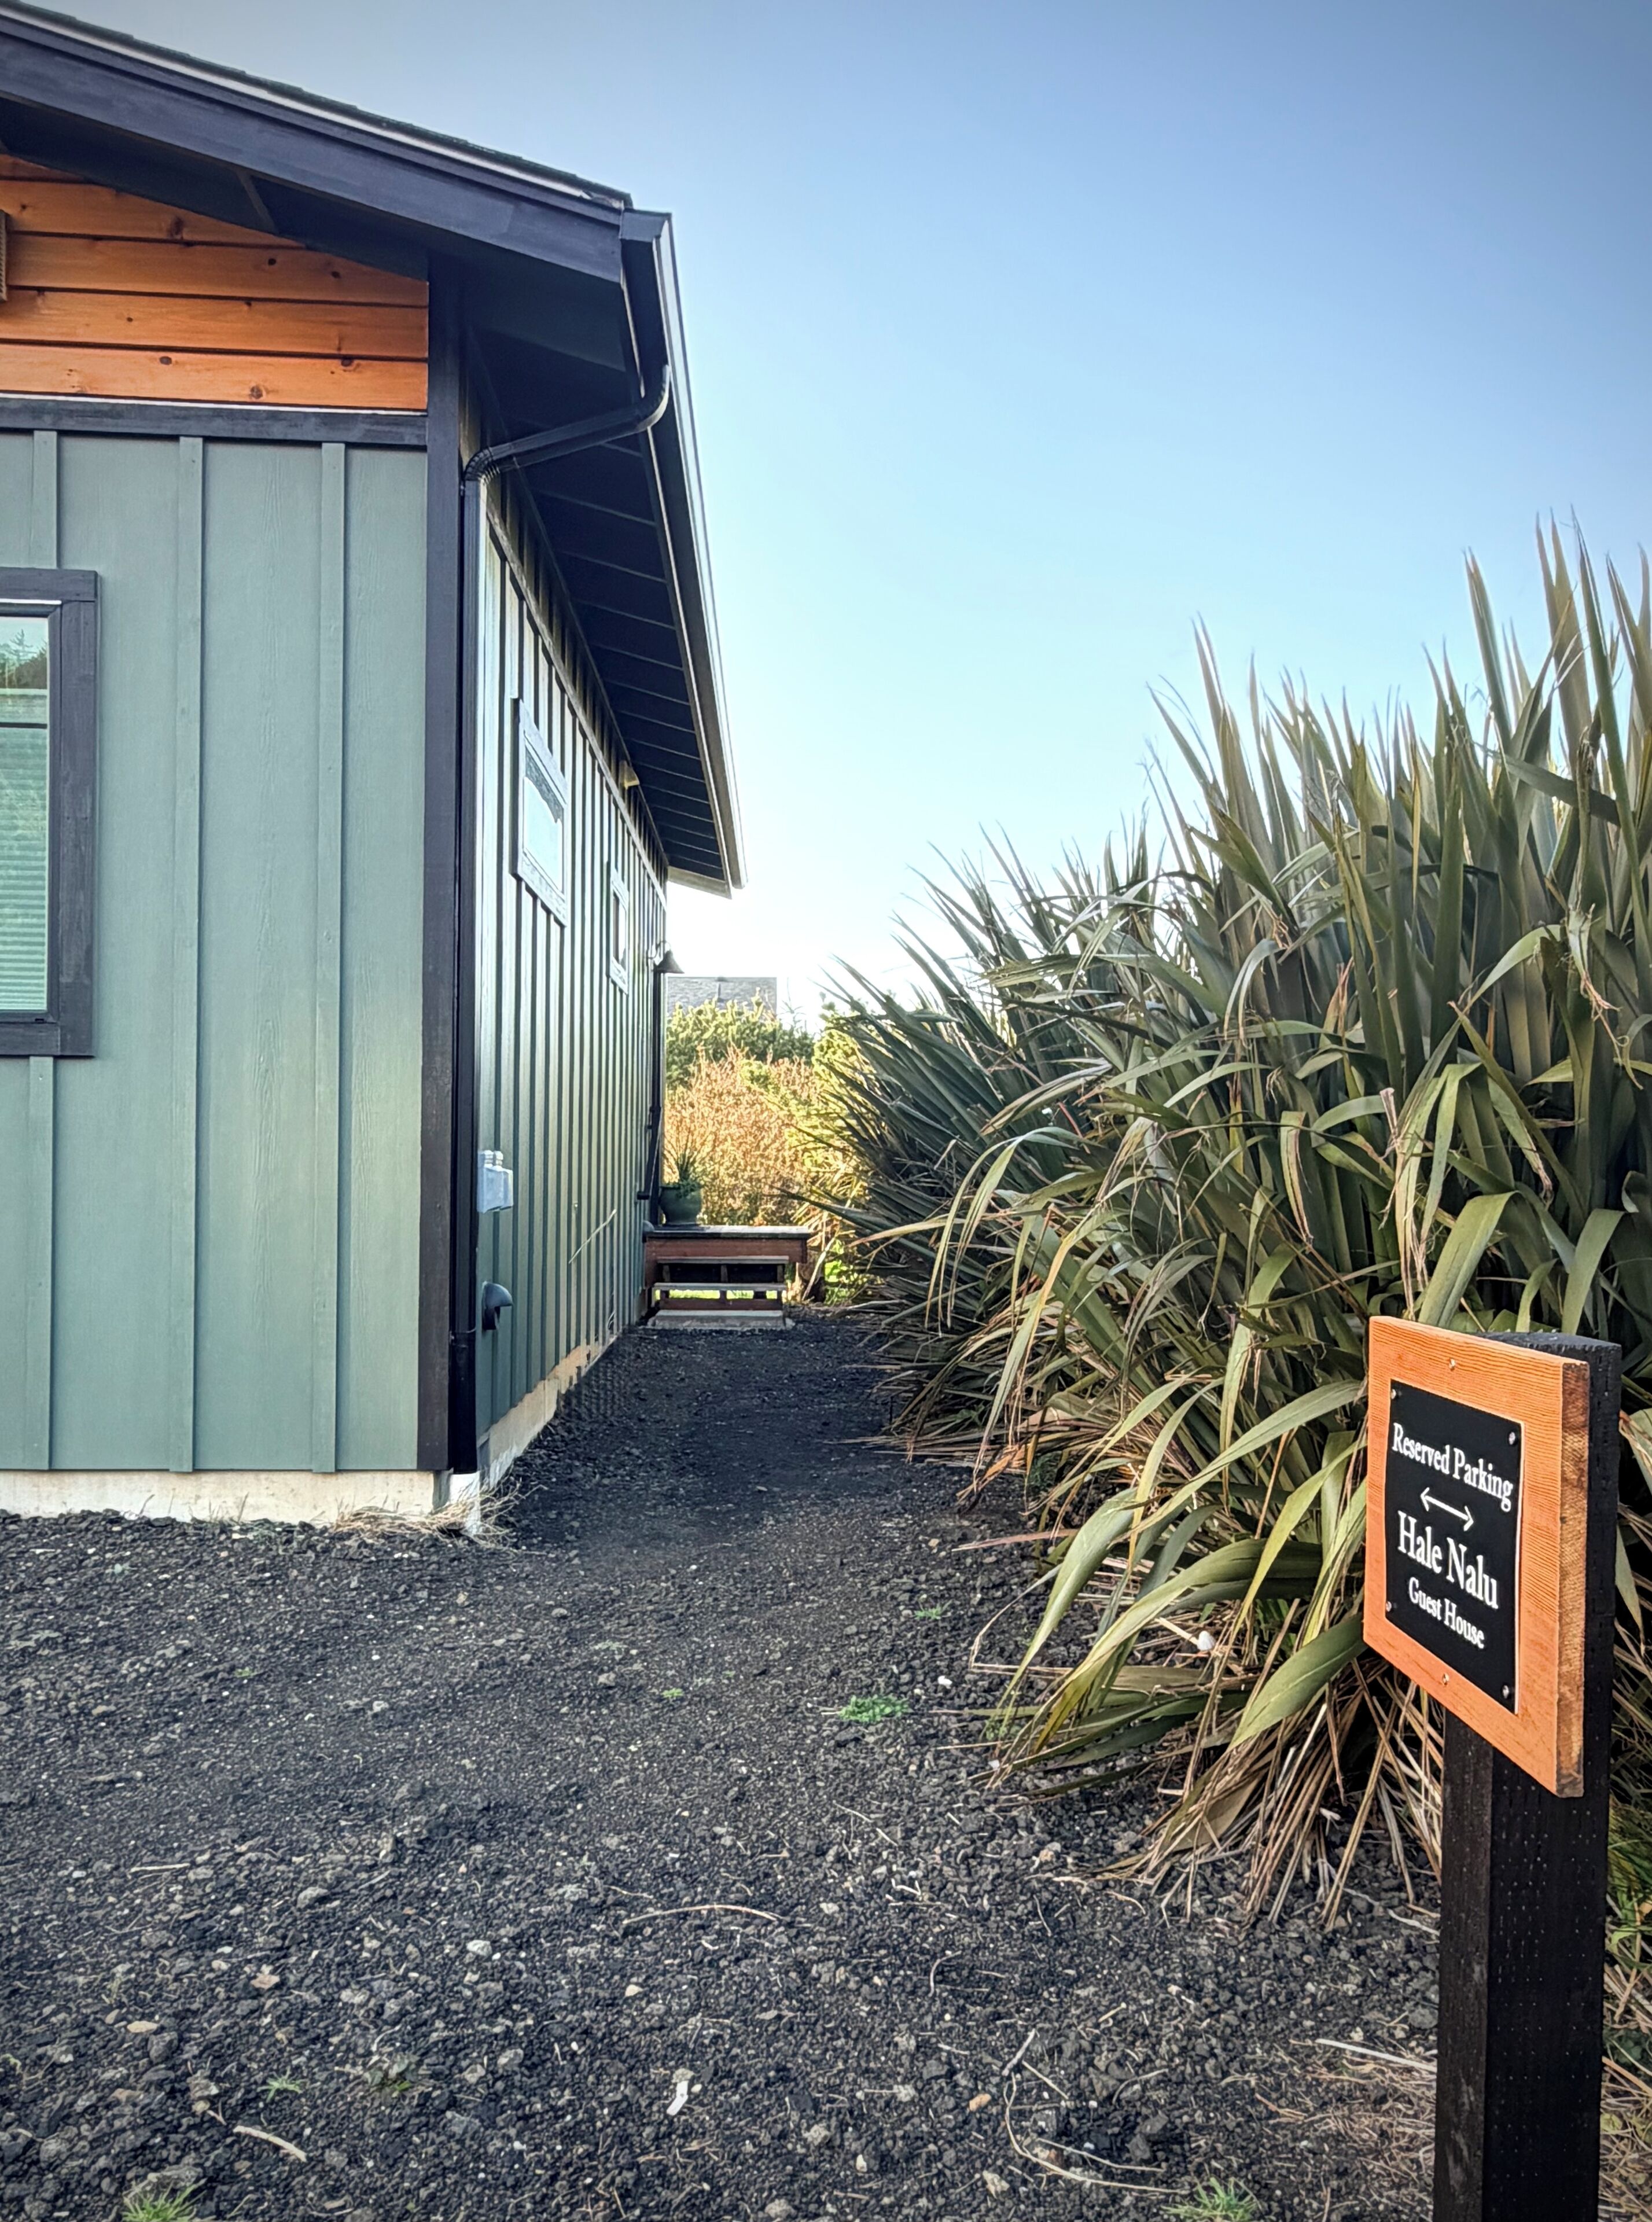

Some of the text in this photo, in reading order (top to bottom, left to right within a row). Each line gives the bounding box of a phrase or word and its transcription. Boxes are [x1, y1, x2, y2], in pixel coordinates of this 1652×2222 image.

[1392, 1422, 1514, 1512] Reserved Parking
[1397, 1510, 1499, 1609] Hale Nalu
[1409, 1577, 1485, 1649] Guest House
